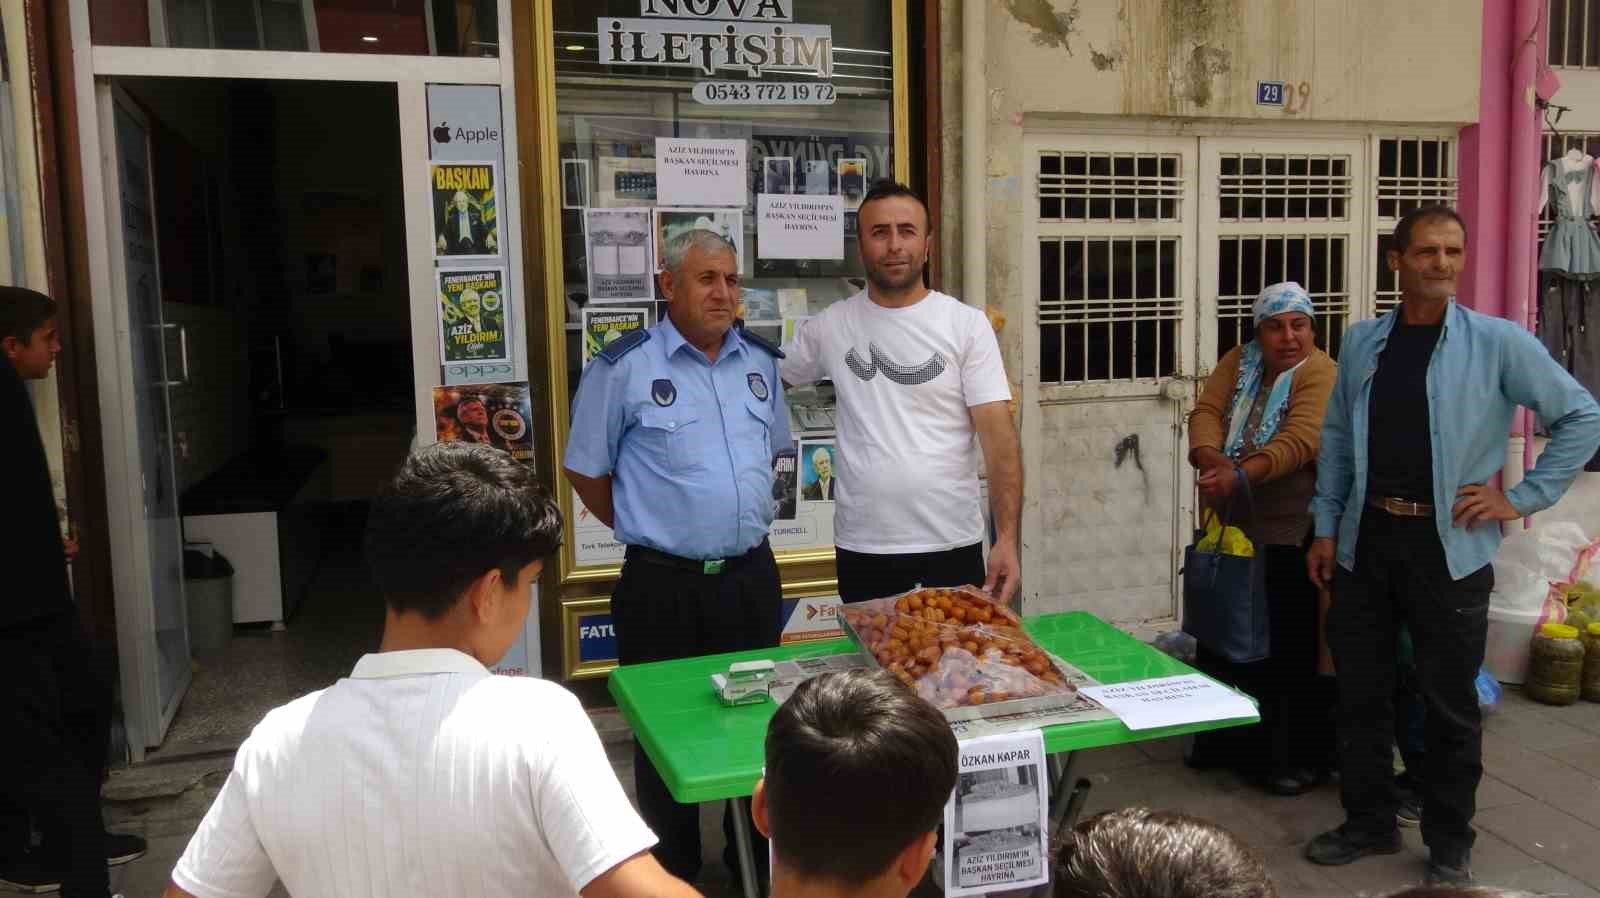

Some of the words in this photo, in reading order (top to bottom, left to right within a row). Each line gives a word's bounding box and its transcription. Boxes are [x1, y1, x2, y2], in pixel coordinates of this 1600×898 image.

[608, 21, 832, 77] İLETİŞİM
[706, 84, 750, 100] 0543
[756, 84, 786, 100] 772
[793, 85, 810, 101] 19
[816, 85, 834, 101] 72
[1263, 85, 1278, 102] 29
[1283, 81, 1311, 113] 29
[456, 127, 498, 144] Apple
[436, 167, 490, 191] BAŞKAN
[451, 322, 472, 336] AZİZ
[454, 330, 497, 344] YILDIRIM
[961, 754, 995, 768] ÖZKAN
[997, 749, 1031, 763] KAPAR
[967, 855, 984, 865] AZİZ
[980, 871, 1015, 881] HAYRINA
